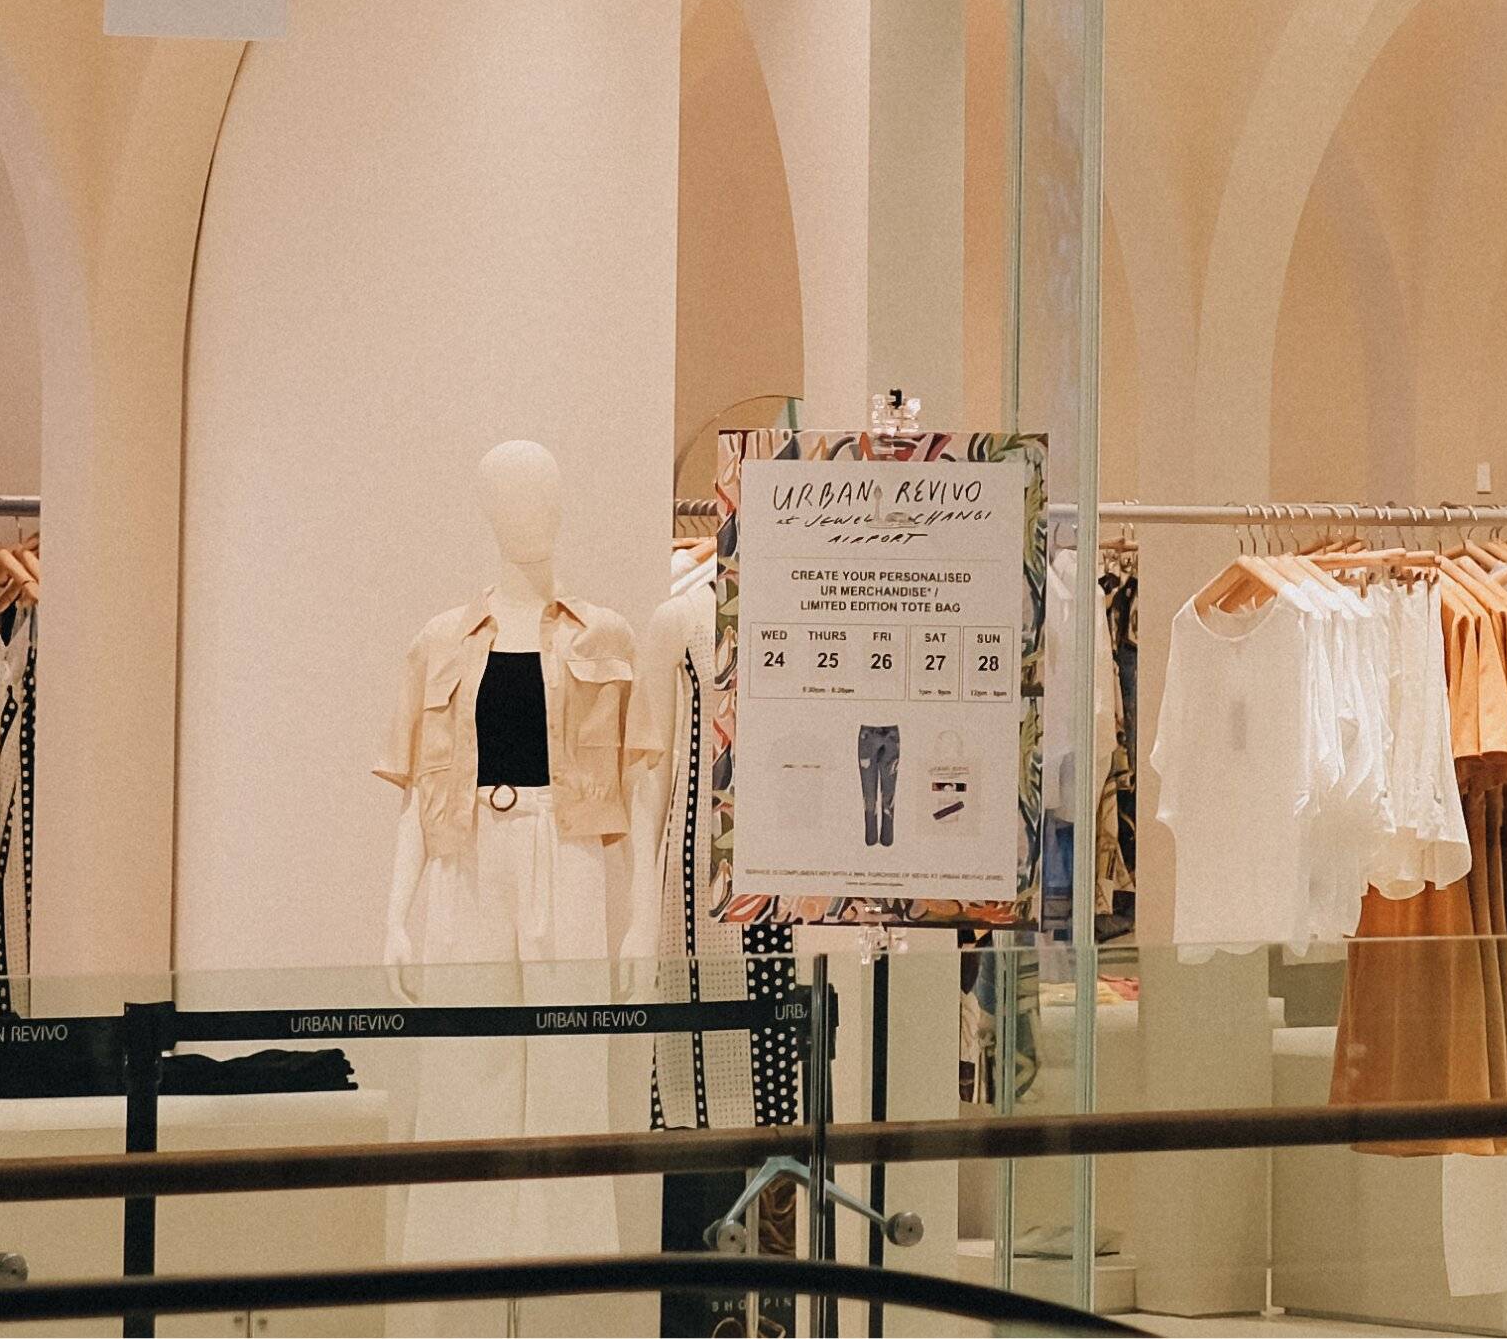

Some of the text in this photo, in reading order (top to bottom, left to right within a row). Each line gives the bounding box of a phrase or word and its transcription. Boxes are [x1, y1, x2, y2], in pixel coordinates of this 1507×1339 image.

[774, 479, 982, 511] URBAN REVIVO
[827, 532, 928, 545] AIRPORT
[791, 571, 972, 583] CREATE YOUR PERSONALISED
[820, 586, 837, 596] UR
[800, 601, 961, 613] LIMITED EDITION TOTE BAG
[761, 630, 1001, 644] WED THURS FRI SAT SUN
[763, 651, 999, 671] 24 25 26 27 28
[290, 1014, 405, 1032] URBAN REVIVO
[535, 1010, 647, 1028] URBAN REVIVO
[11, 1024, 69, 1041] REVIVO
